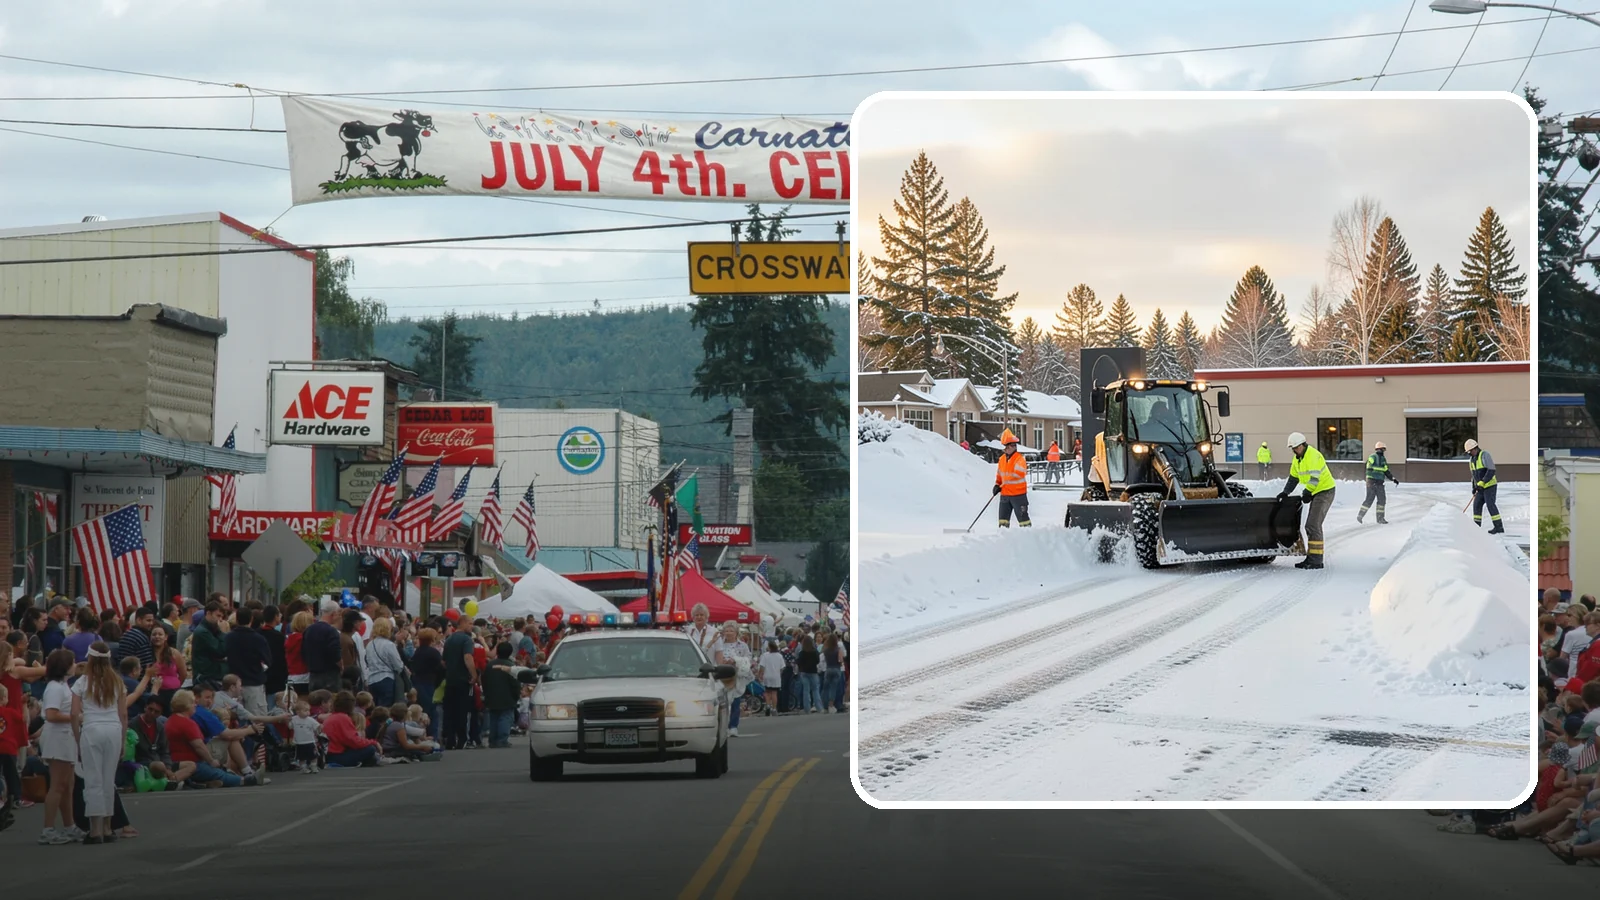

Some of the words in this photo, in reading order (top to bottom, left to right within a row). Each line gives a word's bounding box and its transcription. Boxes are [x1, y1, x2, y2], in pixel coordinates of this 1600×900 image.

[695, 121, 850, 150] Carnat
[481, 141, 605, 192] JULY
[632, 150, 746, 197] 4th.
[697, 254, 850, 280] CROSSWA
[283, 380, 373, 420] ACE
[405, 409, 453, 422] CEDAR
[284, 421, 370, 437] Hardware
[416, 428, 476, 447] Coca-Cola
[353, 467, 387, 481] Simpl
[83, 485, 94, 494] St.
[96, 486, 124, 495] Vincent
[126, 486, 136, 495] de
[138, 486, 155, 495] Paul
[688, 526, 741, 535] CRNATION
[699, 535, 730, 543] GLASS
